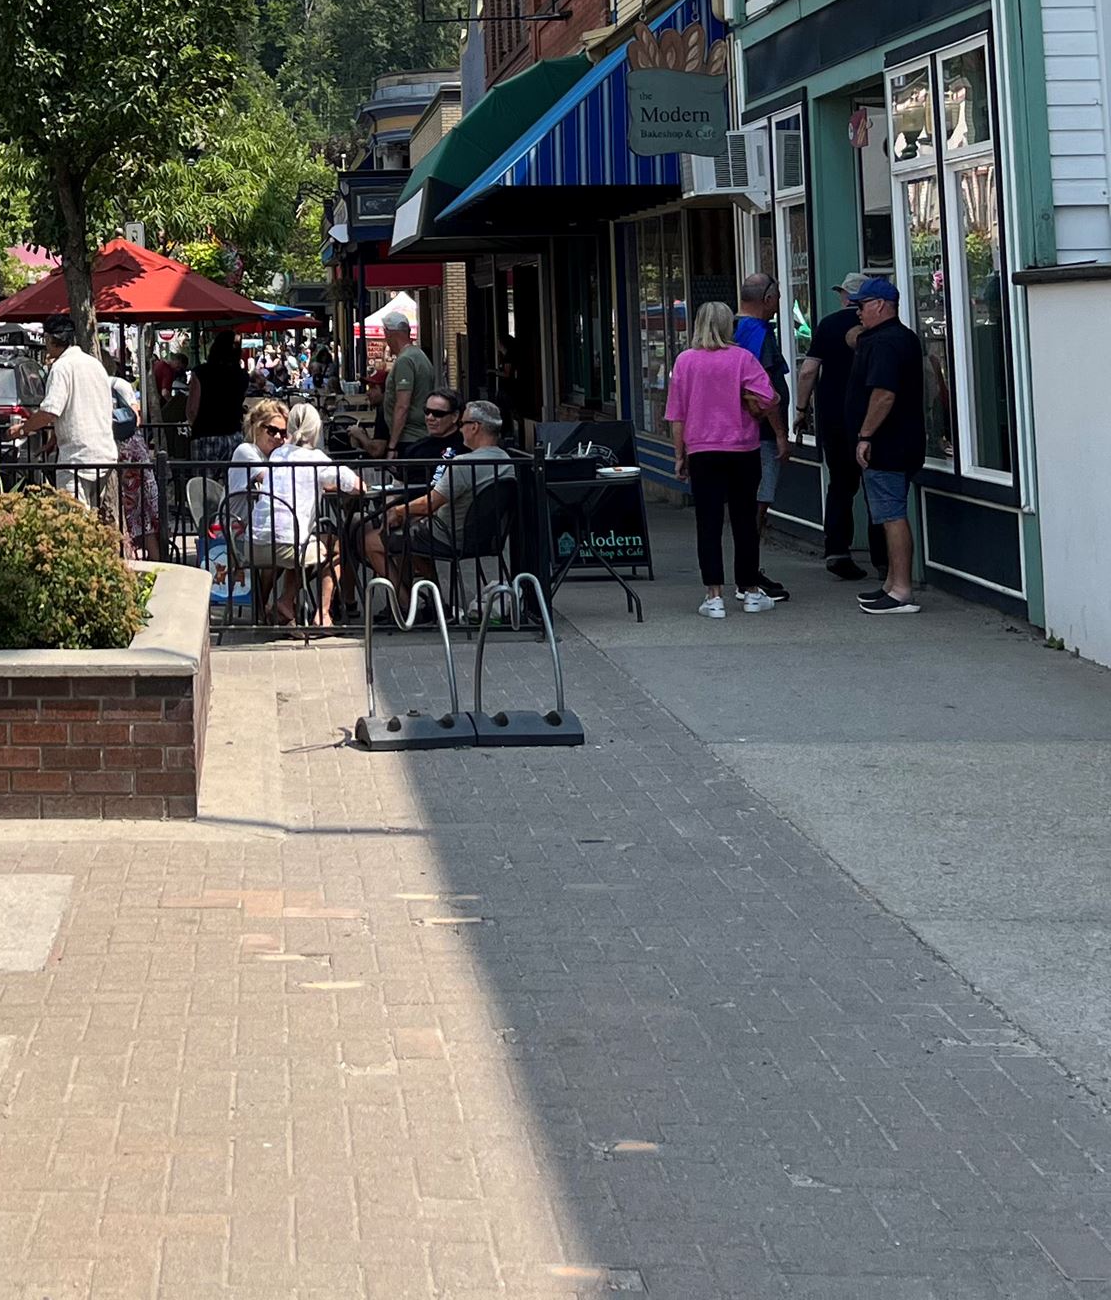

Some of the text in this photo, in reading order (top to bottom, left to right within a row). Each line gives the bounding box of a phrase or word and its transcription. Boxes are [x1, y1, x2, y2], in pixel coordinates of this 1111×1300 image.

[640, 92, 652, 100] the
[640, 106, 710, 123] Modern
[640, 129, 683, 140] Bakeshop
[685, 129, 695, 138] &
[580, 548, 615, 559] Bakhop
[617, 549, 624, 557] &
